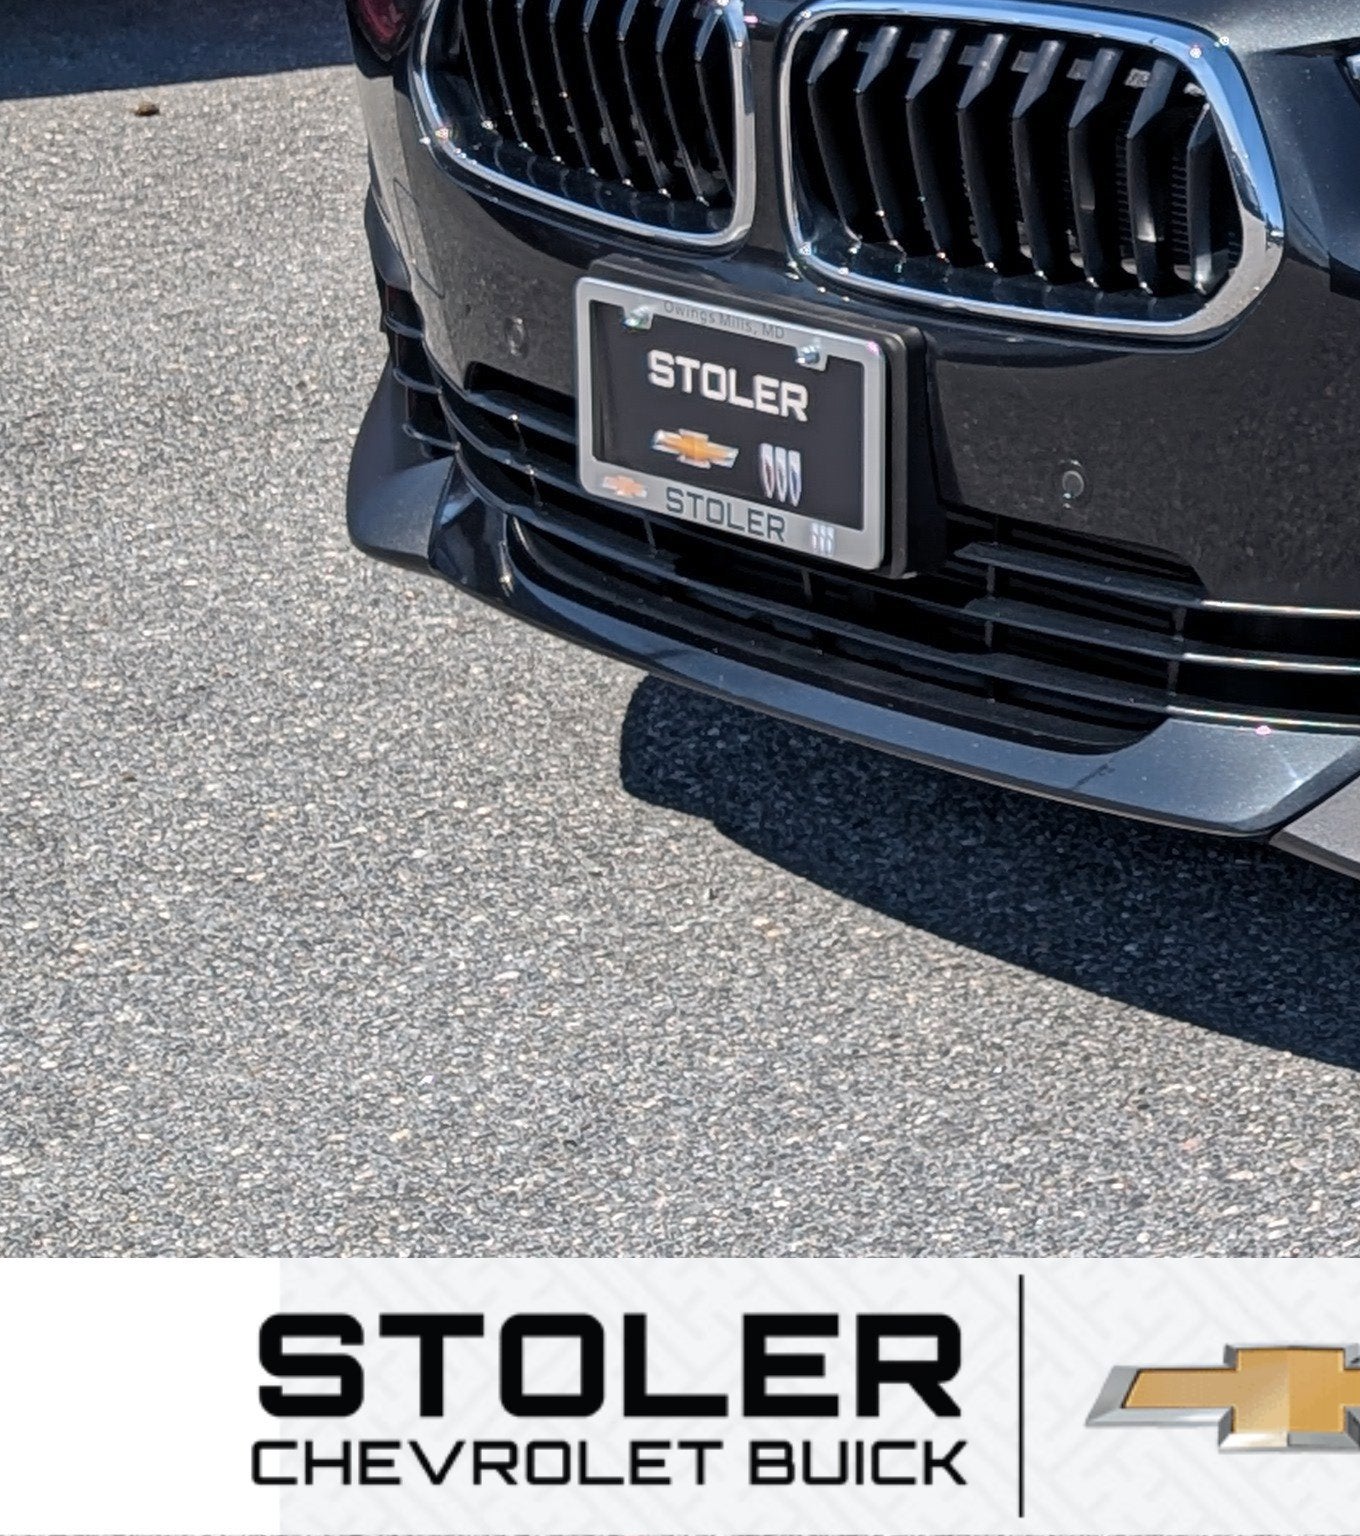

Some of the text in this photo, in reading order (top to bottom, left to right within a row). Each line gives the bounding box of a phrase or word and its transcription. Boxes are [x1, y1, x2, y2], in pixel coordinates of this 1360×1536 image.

[663, 300, 716, 324] Owings
[762, 323, 785, 339] MD
[647, 349, 809, 423] STOLER
[665, 486, 786, 543] STOLER
